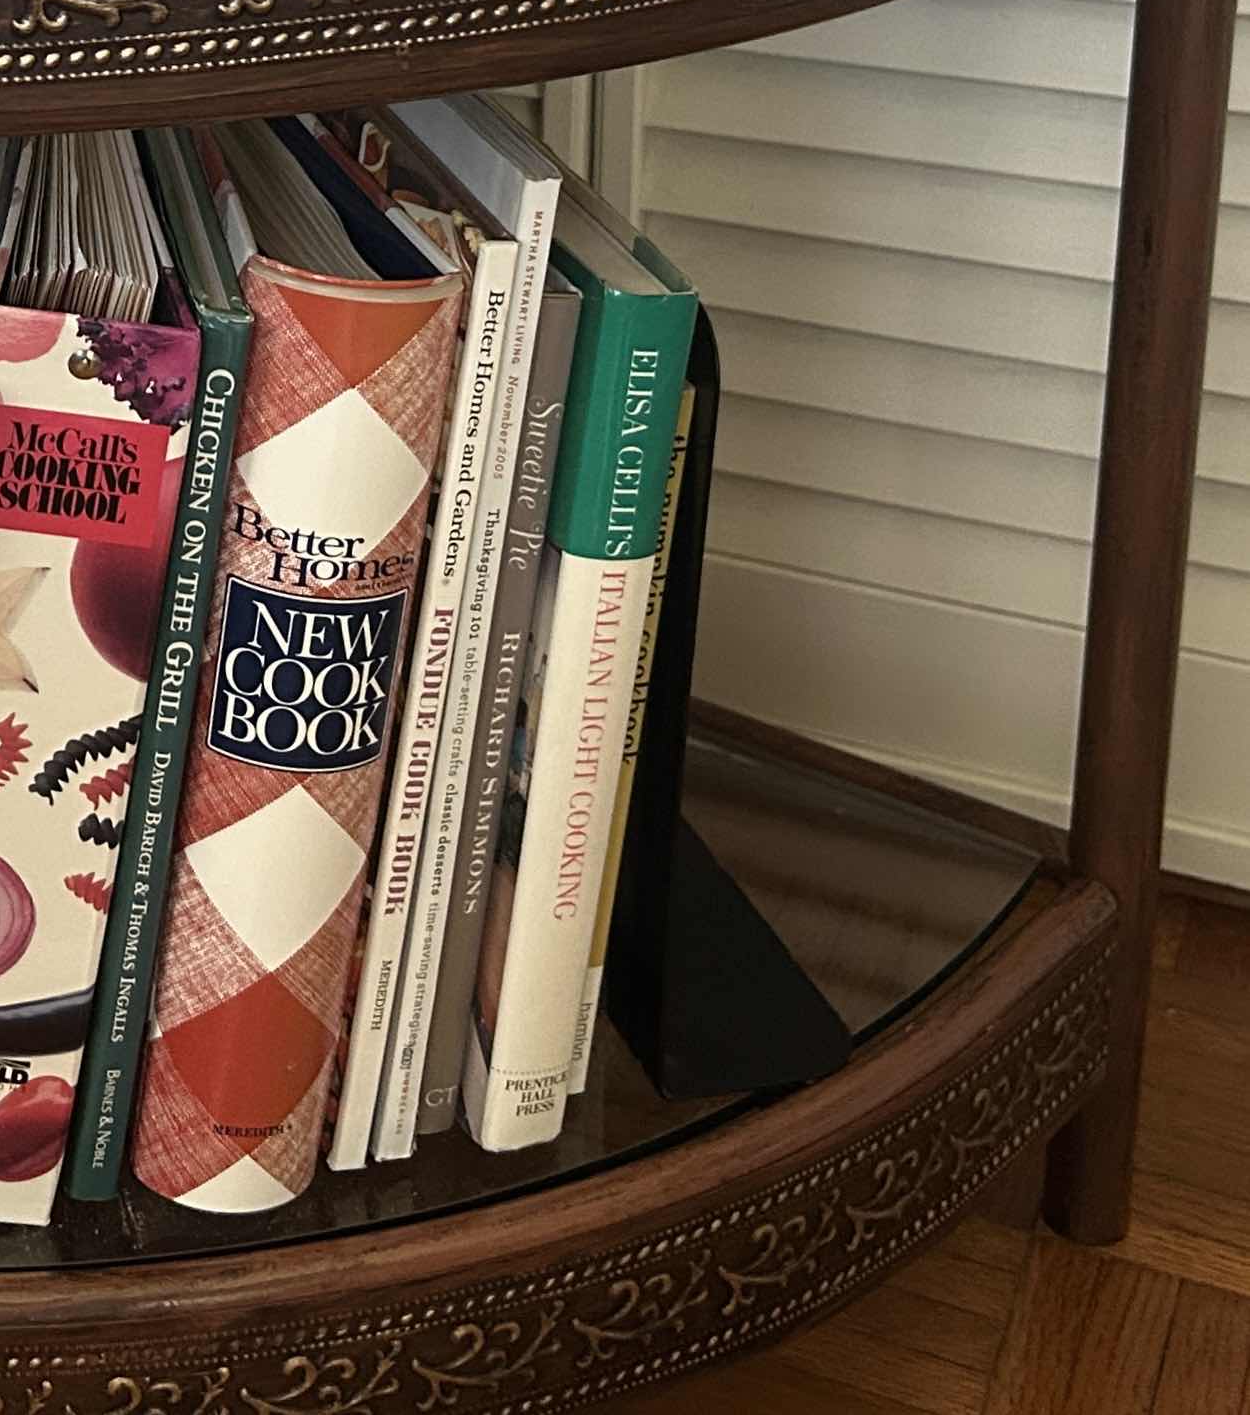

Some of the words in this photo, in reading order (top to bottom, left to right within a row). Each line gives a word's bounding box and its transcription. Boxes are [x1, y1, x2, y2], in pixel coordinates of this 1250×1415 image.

[528, 210, 545, 262] MARTHA
[481, 289, 506, 358] Better
[518, 264, 535, 324] STEWART
[497, 375, 519, 445] November
[623, 349, 659, 437] ELISA
[8, 421, 138, 466] McCall's
[190, 368, 236, 514] CHICKEN
[183, 520, 207, 565] ON
[230, 503, 365, 559] Better
[247, 599, 389, 660] NEW
[587, 571, 627, 688] ITALIAN
[155, 641, 196, 732] GRILL
[224, 648, 387, 709] COOK
[415, 607, 459, 730] FONDUE
[487, 632, 521, 768] RICHARD
[219, 691, 385, 757] BOOK
[571, 696, 609, 784] LIGHT
[145, 752, 172, 808] DAVID
[401, 740, 433, 821] COOK
[139, 812, 163, 879] BARICH
[385, 833, 420, 916] BOOK
[431, 835, 450, 896] desserts
[465, 774, 499, 915] SIMMONS
[554, 791, 595, 921] COOKING
[121, 899, 148, 972] THOMAS
[111, 976, 136, 1043] INGALLS
[371, 959, 394, 1032] MEREDITH
[505, 1071, 568, 1092] PRENTICE
[516, 1100, 555, 1116] PRESS
[521, 1087, 555, 1102] HALL
